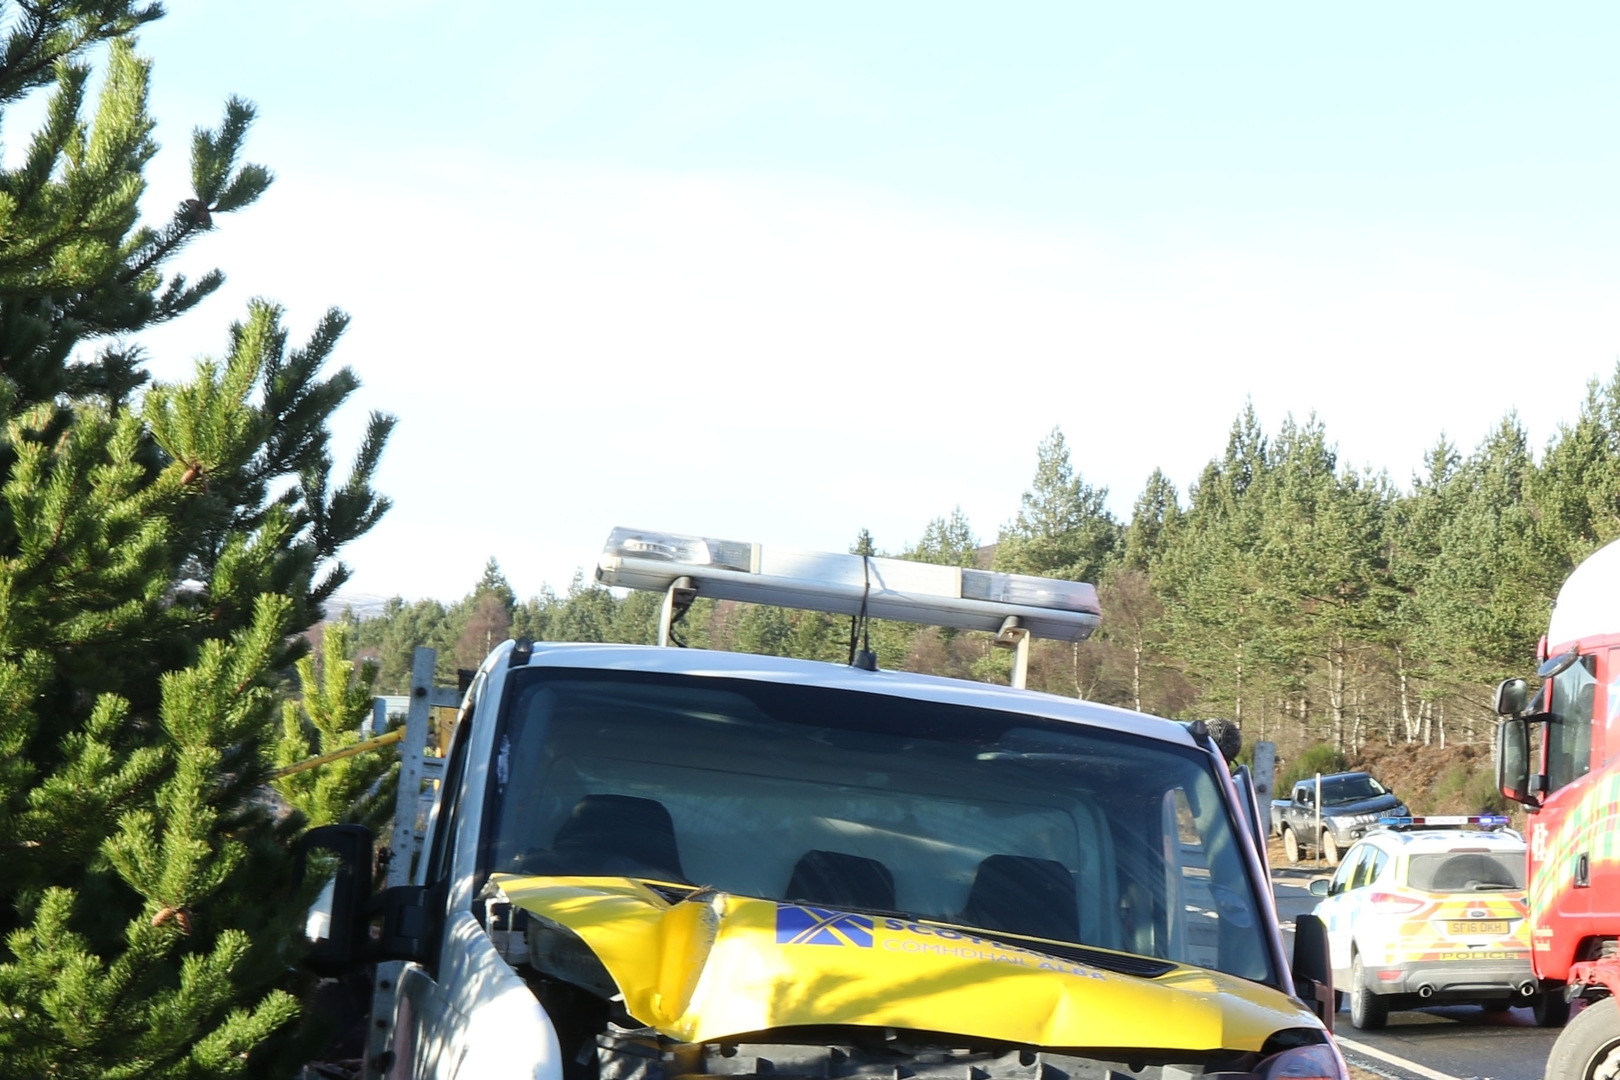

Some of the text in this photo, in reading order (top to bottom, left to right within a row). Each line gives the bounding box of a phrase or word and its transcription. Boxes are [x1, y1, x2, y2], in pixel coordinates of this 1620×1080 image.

[1453, 922, 1477, 933] SF16
[1442, 951, 1516, 960] POLICE
[1037, 962, 1106, 981] ALBA
